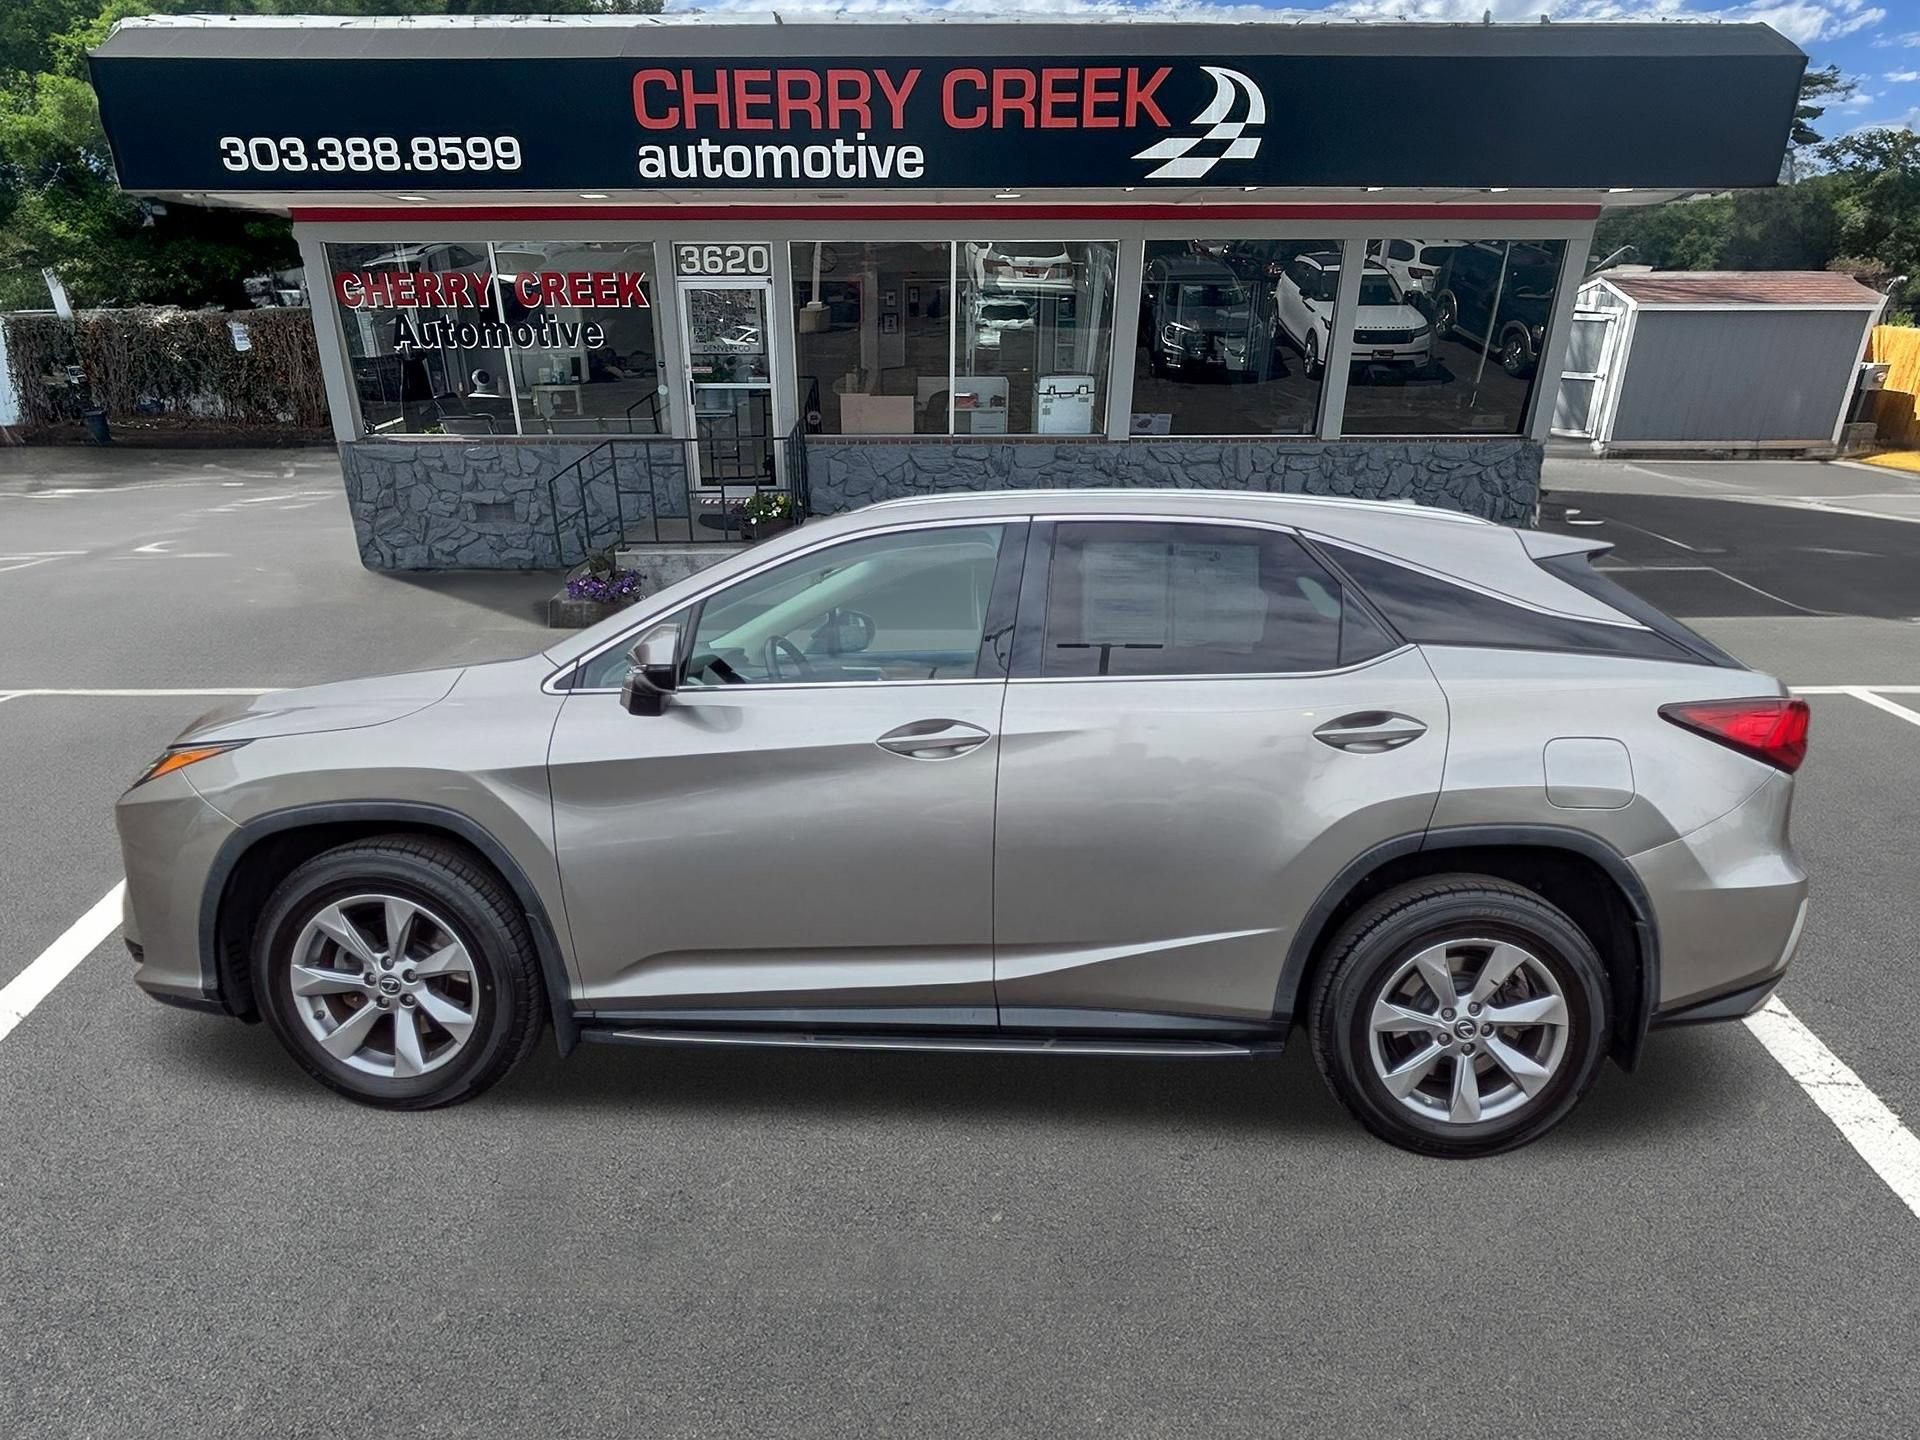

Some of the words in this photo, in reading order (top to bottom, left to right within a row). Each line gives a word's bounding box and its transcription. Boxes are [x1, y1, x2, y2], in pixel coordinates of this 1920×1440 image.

[632, 68, 921, 130] CHERRY
[942, 67, 1172, 129] CREEK
[219, 135, 522, 172] 303.388.8599
[637, 132, 924, 178] automotive
[680, 246, 769, 273] 3620
[335, 271, 493, 309] CHERRY
[515, 271, 650, 308] CREEK
[393, 312, 606, 350] Automotive
